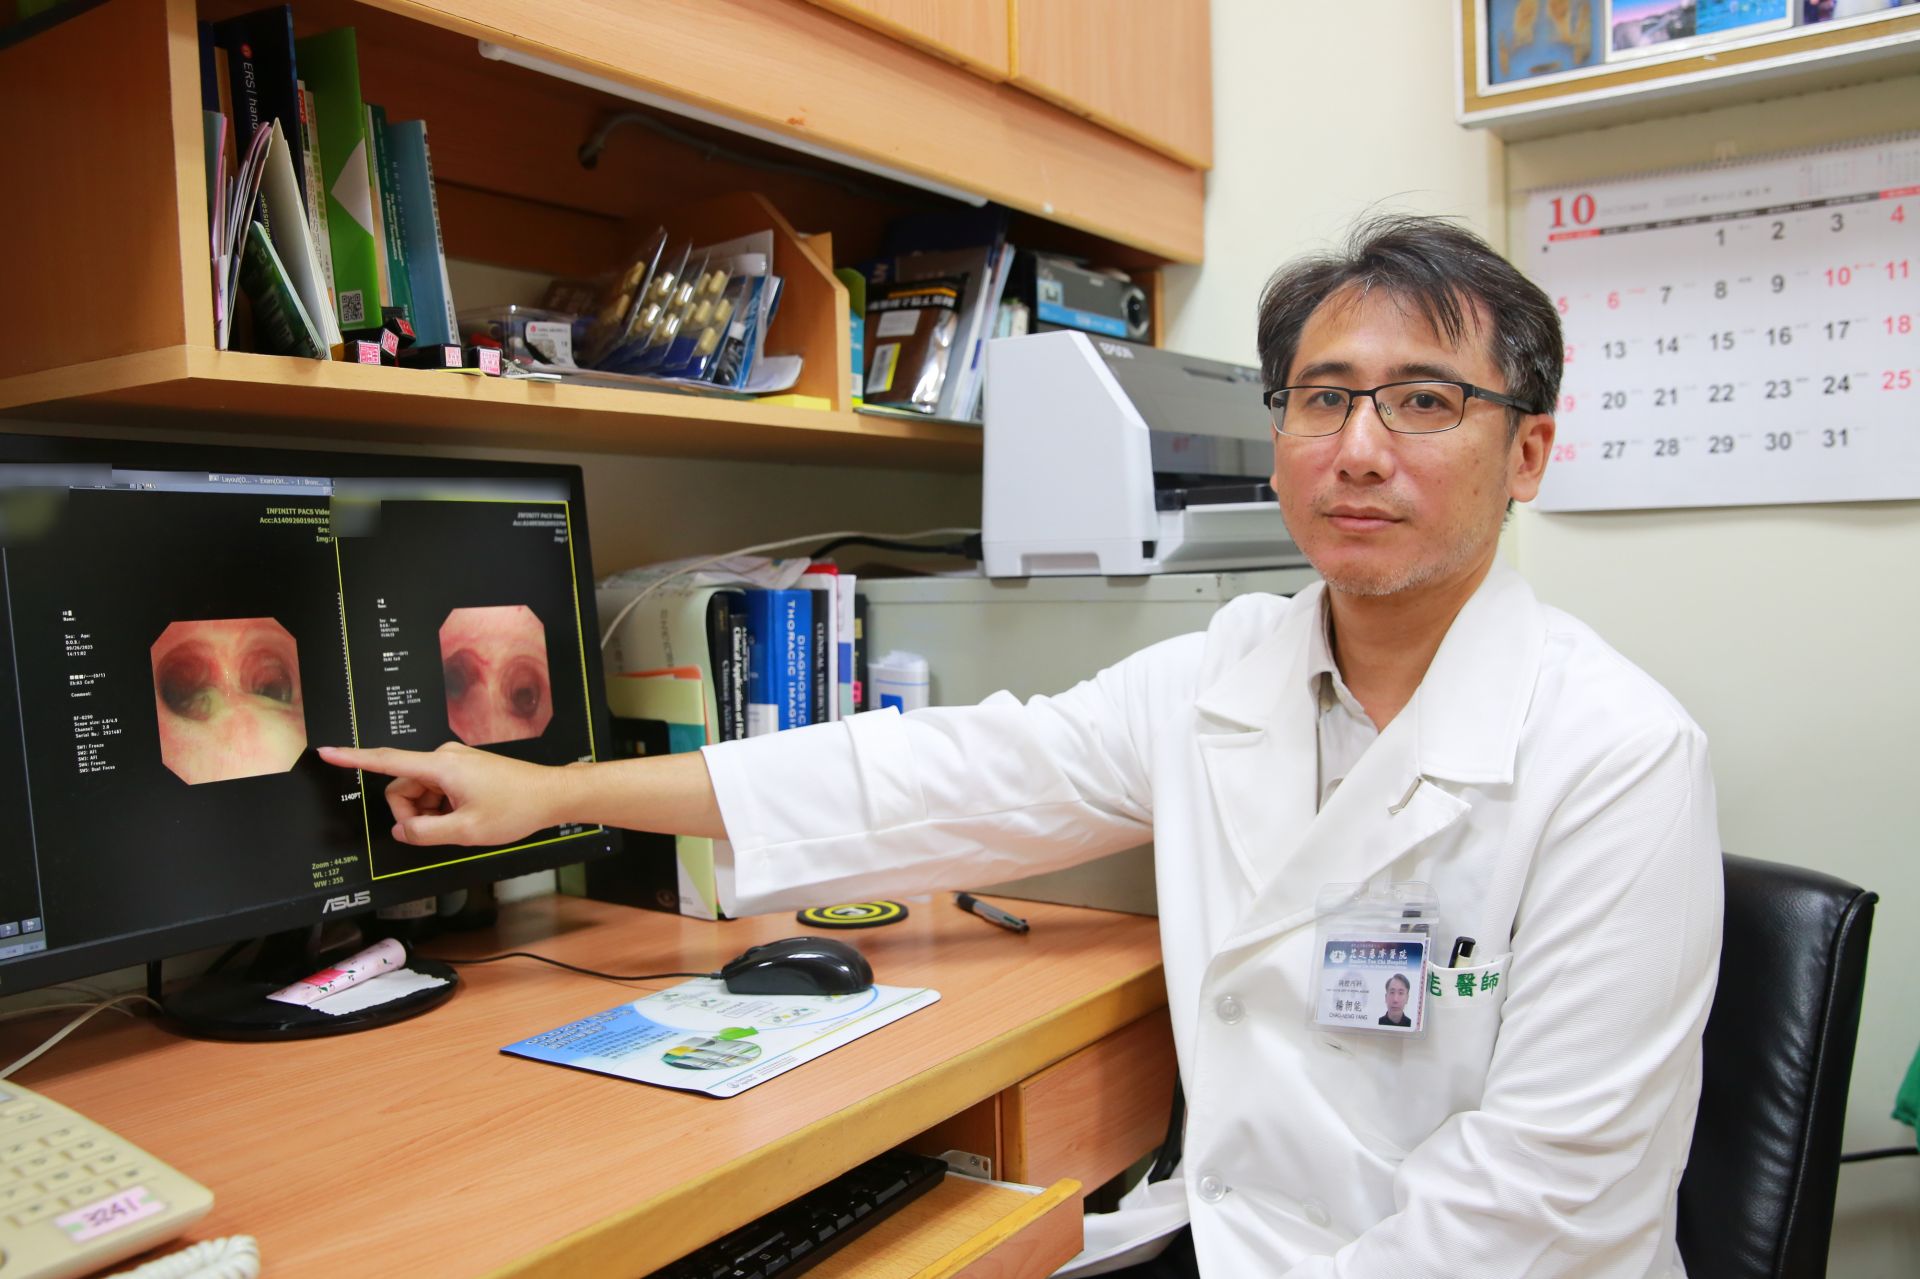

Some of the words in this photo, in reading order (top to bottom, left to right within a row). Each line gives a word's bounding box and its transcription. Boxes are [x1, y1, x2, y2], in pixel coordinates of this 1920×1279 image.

[1549, 193, 1597, 229] 10
[1716, 229, 1724, 246] 1
[1772, 221, 1784, 240] 2
[1832, 213, 1844, 232] 3
[1891, 205, 1904, 223] 4
[1558, 298, 1568, 314] 5
[1608, 292, 1619, 308] 6
[1661, 286, 1672, 303] 7
[1715, 281, 1727, 299] 8
[1772, 275, 1784, 293] 9
[1825, 266, 1851, 286] 10
[1886, 260, 1908, 279] 11
[1565, 346, 1574, 362] 2
[1604, 341, 1626, 358] 13
[1656, 337, 1678, 354] 14
[1710, 332, 1734, 350] 15
[1767, 327, 1792, 345] 16
[1825, 320, 1850, 340] 17
[1884, 314, 1911, 334] 18
[1603, 392, 1626, 410] 20
[1655, 388, 1677, 406] 21
[1709, 384, 1734, 403] 22
[1765, 380, 1792, 399] 23
[1824, 376, 1849, 394] 24
[1883, 370, 1911, 390] 25
[1553, 445, 1575, 461] 26
[1603, 441, 1626, 459] 27
[1655, 438, 1679, 456] 28
[1709, 436, 1734, 453] 29
[1766, 432, 1792, 451] 30
[1824, 429, 1847, 448] 31
[787, 600, 796, 676] THORACIC
[797, 635, 806, 726] DIAGNOSTIC
[312, 862, 329, 870] Zoom
[322, 890, 371, 914] ASUS
